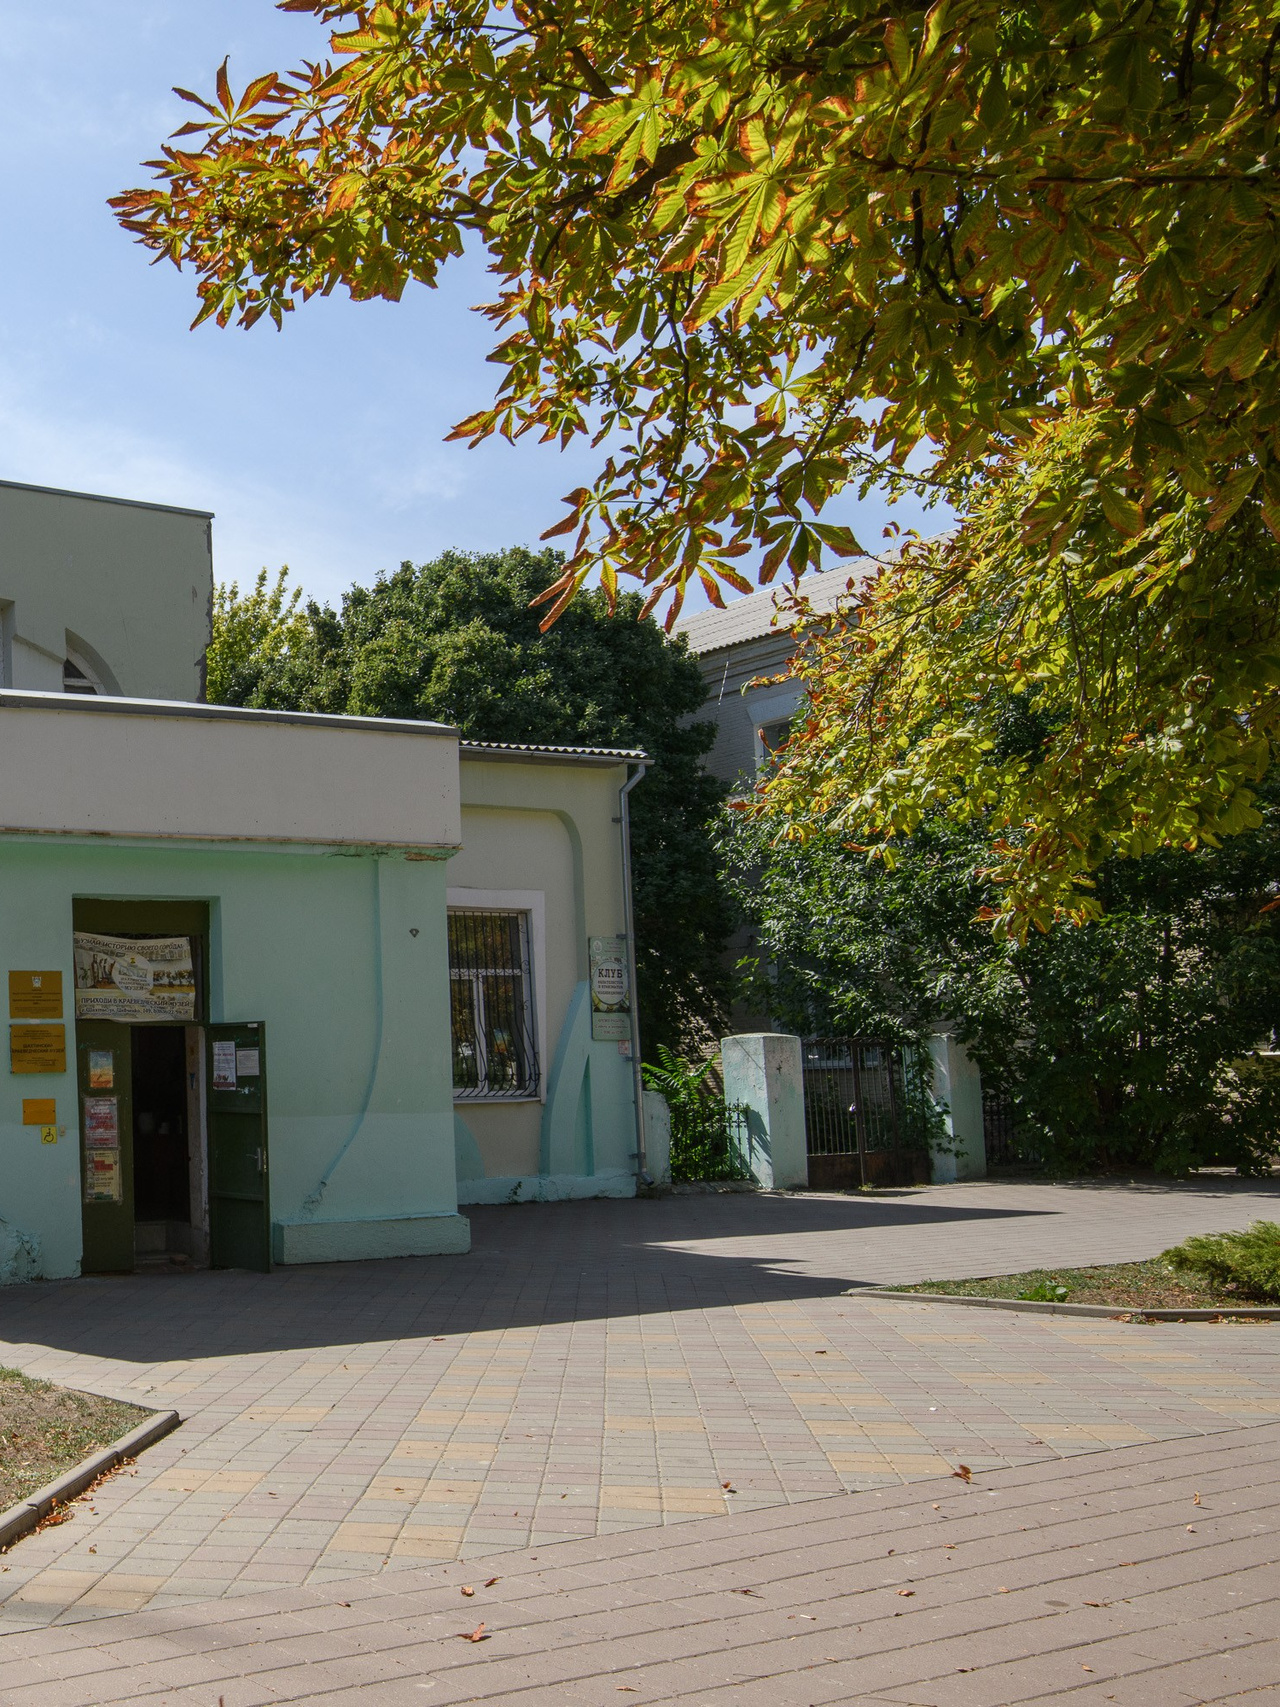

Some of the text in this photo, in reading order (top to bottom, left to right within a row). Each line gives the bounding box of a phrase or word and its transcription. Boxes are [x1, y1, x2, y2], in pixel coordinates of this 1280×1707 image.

[101, 941, 135, 951] ИСТОРИЮ
[136, 943, 158, 951] СВОЕГО
[597, 968, 623, 978] КЛУБ
[118, 998, 168, 1006] КРАЕВЕДЧЕСКИЙ
